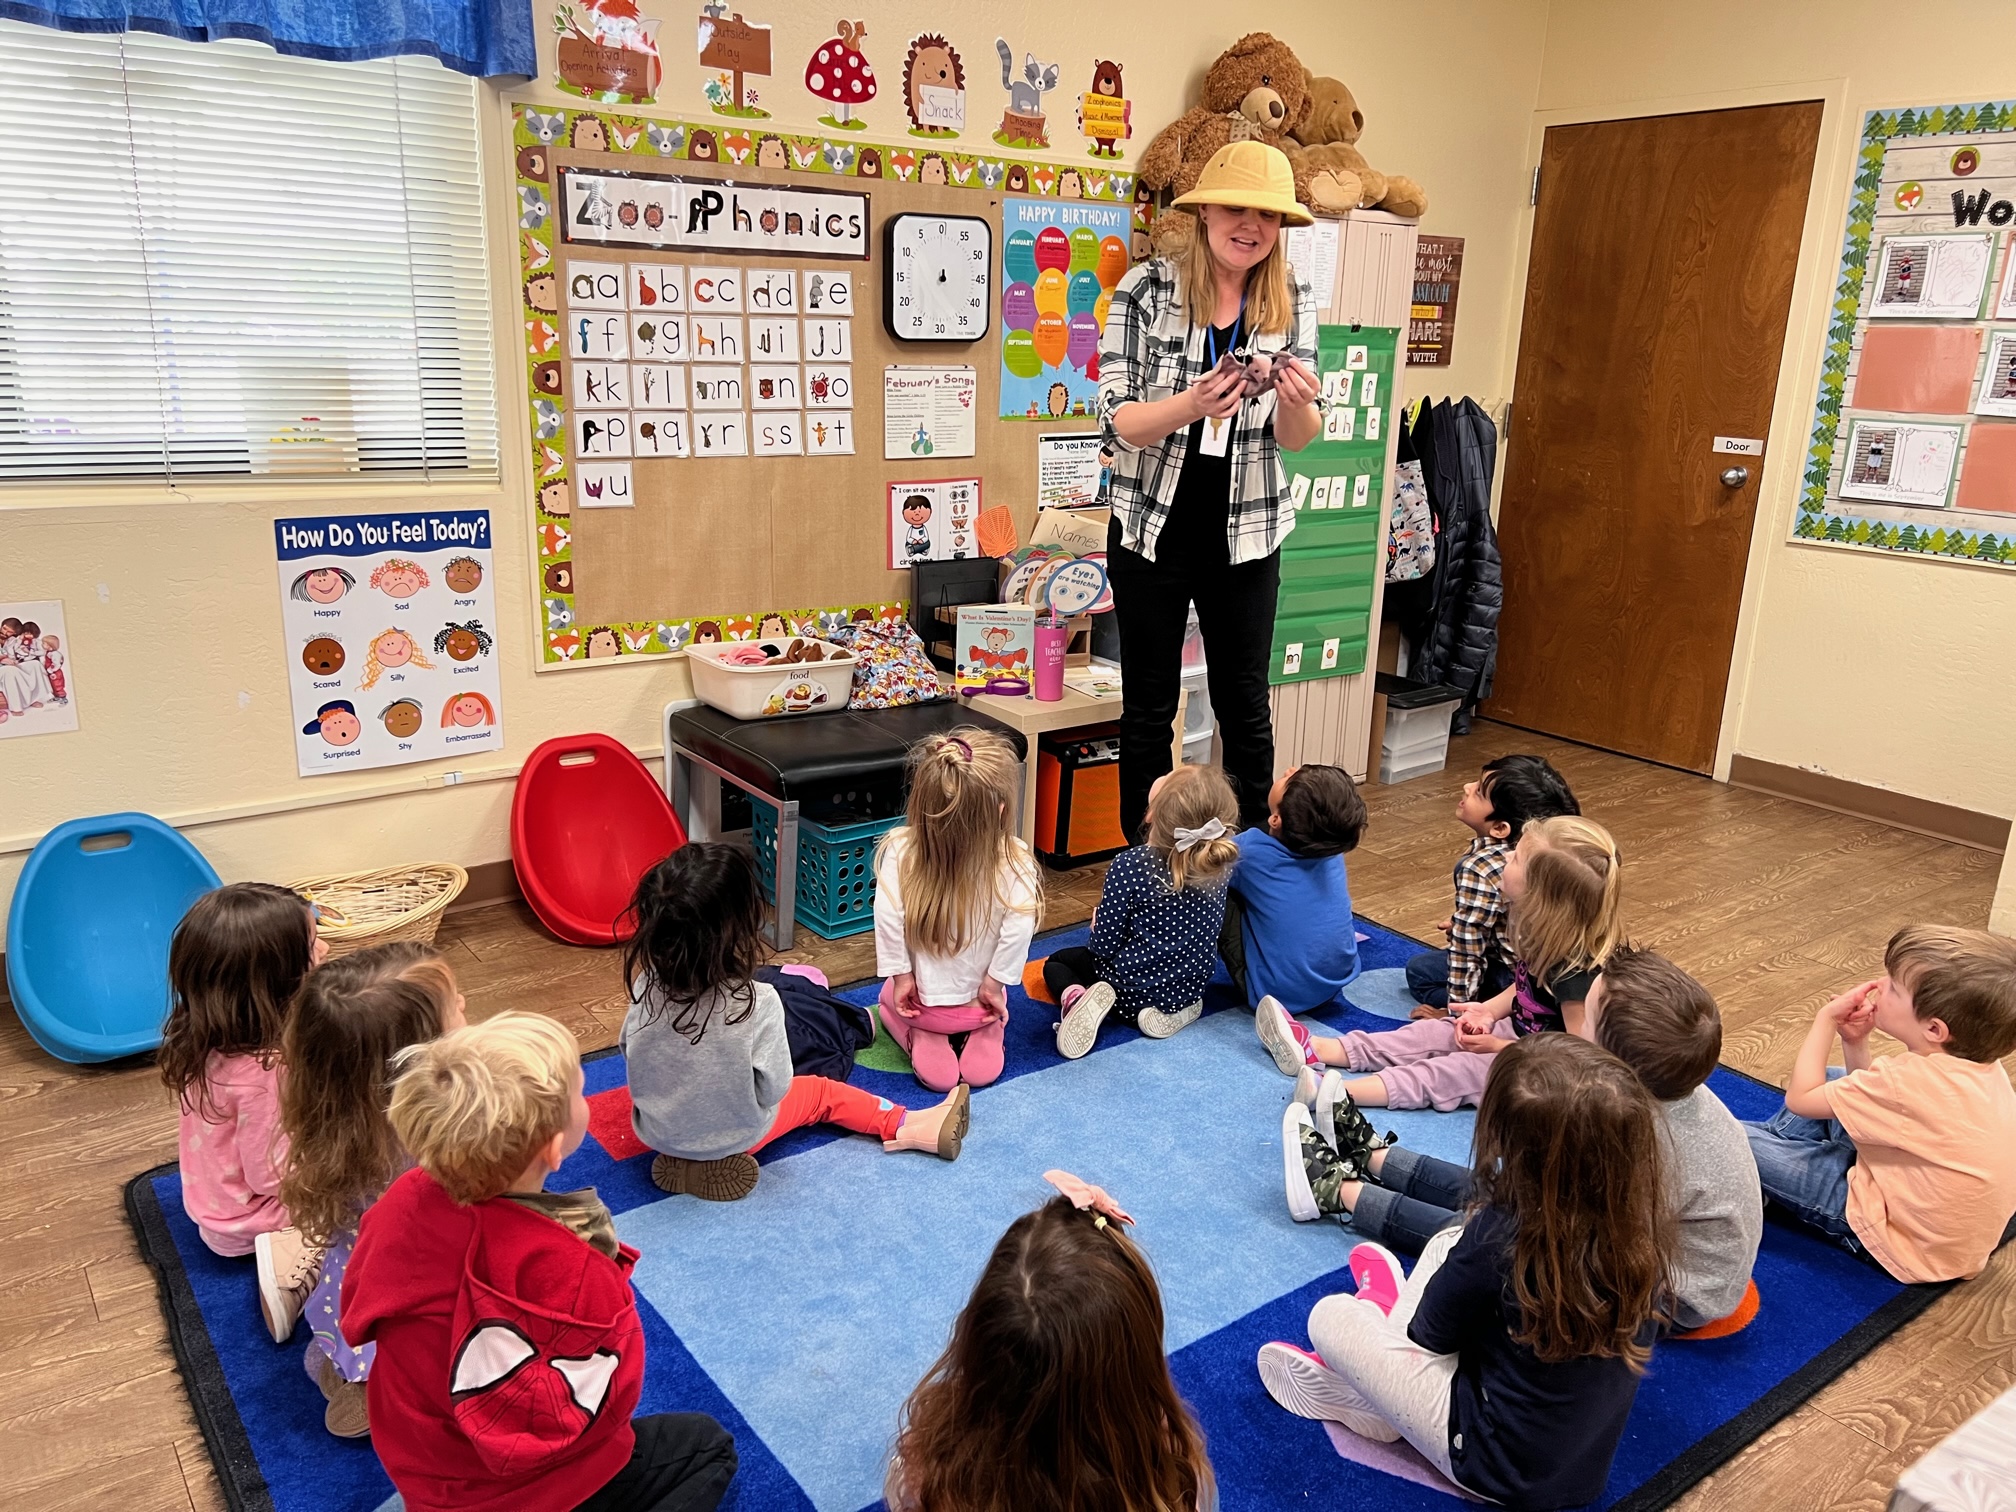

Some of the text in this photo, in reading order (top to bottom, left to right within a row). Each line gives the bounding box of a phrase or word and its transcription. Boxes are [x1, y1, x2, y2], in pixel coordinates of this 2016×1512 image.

[711, 25, 752, 41] Outside
[583, 44, 627, 62] Arrival
[717, 43, 740, 63] Play
[560, 60, 594, 77] Opening
[925, 94, 963, 120] Snack
[1009, 114, 1041, 130] Choosing
[1018, 205, 1120, 227] HAPPY BIRTHDAY!
[918, 229, 924, 239] 5
[938, 224, 944, 235] 0
[959, 231, 969, 241] 55
[1076, 233, 1093, 241] MARCH
[1009, 238, 1033, 246] JANUARY
[902, 246, 911, 257] 10
[973, 250, 983, 260] 50
[1428, 253, 1453, 273] most
[896, 272, 905, 282] 15
[975, 275, 986, 285] 45
[899, 297, 910, 307] 20
[970, 298, 980, 308] 40
[912, 317, 923, 327] 25
[958, 316, 968, 326] 35
[934, 324, 945, 334] 30
[1412, 352, 1438, 363] WITH
[886, 374, 974, 388] February's Songs
[1054, 442, 1063, 450] Do
[1066, 443, 1078, 451] you
[1725, 440, 1751, 452] Door
[281, 516, 487, 550] How Do You Feel Today?
[1050, 523, 1100, 550] Names
[1072, 567, 1095, 580] Eyes
[1071, 577, 1101, 591] watching
[394, 602, 410, 611] Sad
[453, 598, 477, 608] Angry
[313, 608, 342, 619] Happy
[985, 615, 1016, 623] Valentine's
[453, 665, 479, 675] Excited
[789, 670, 810, 680] food
[390, 673, 405, 683] Silly
[312, 679, 342, 690] Scared
[445, 730, 492, 744] Embarrassed
[398, 742, 413, 751] Shy
[322, 748, 361, 760] Surprised
